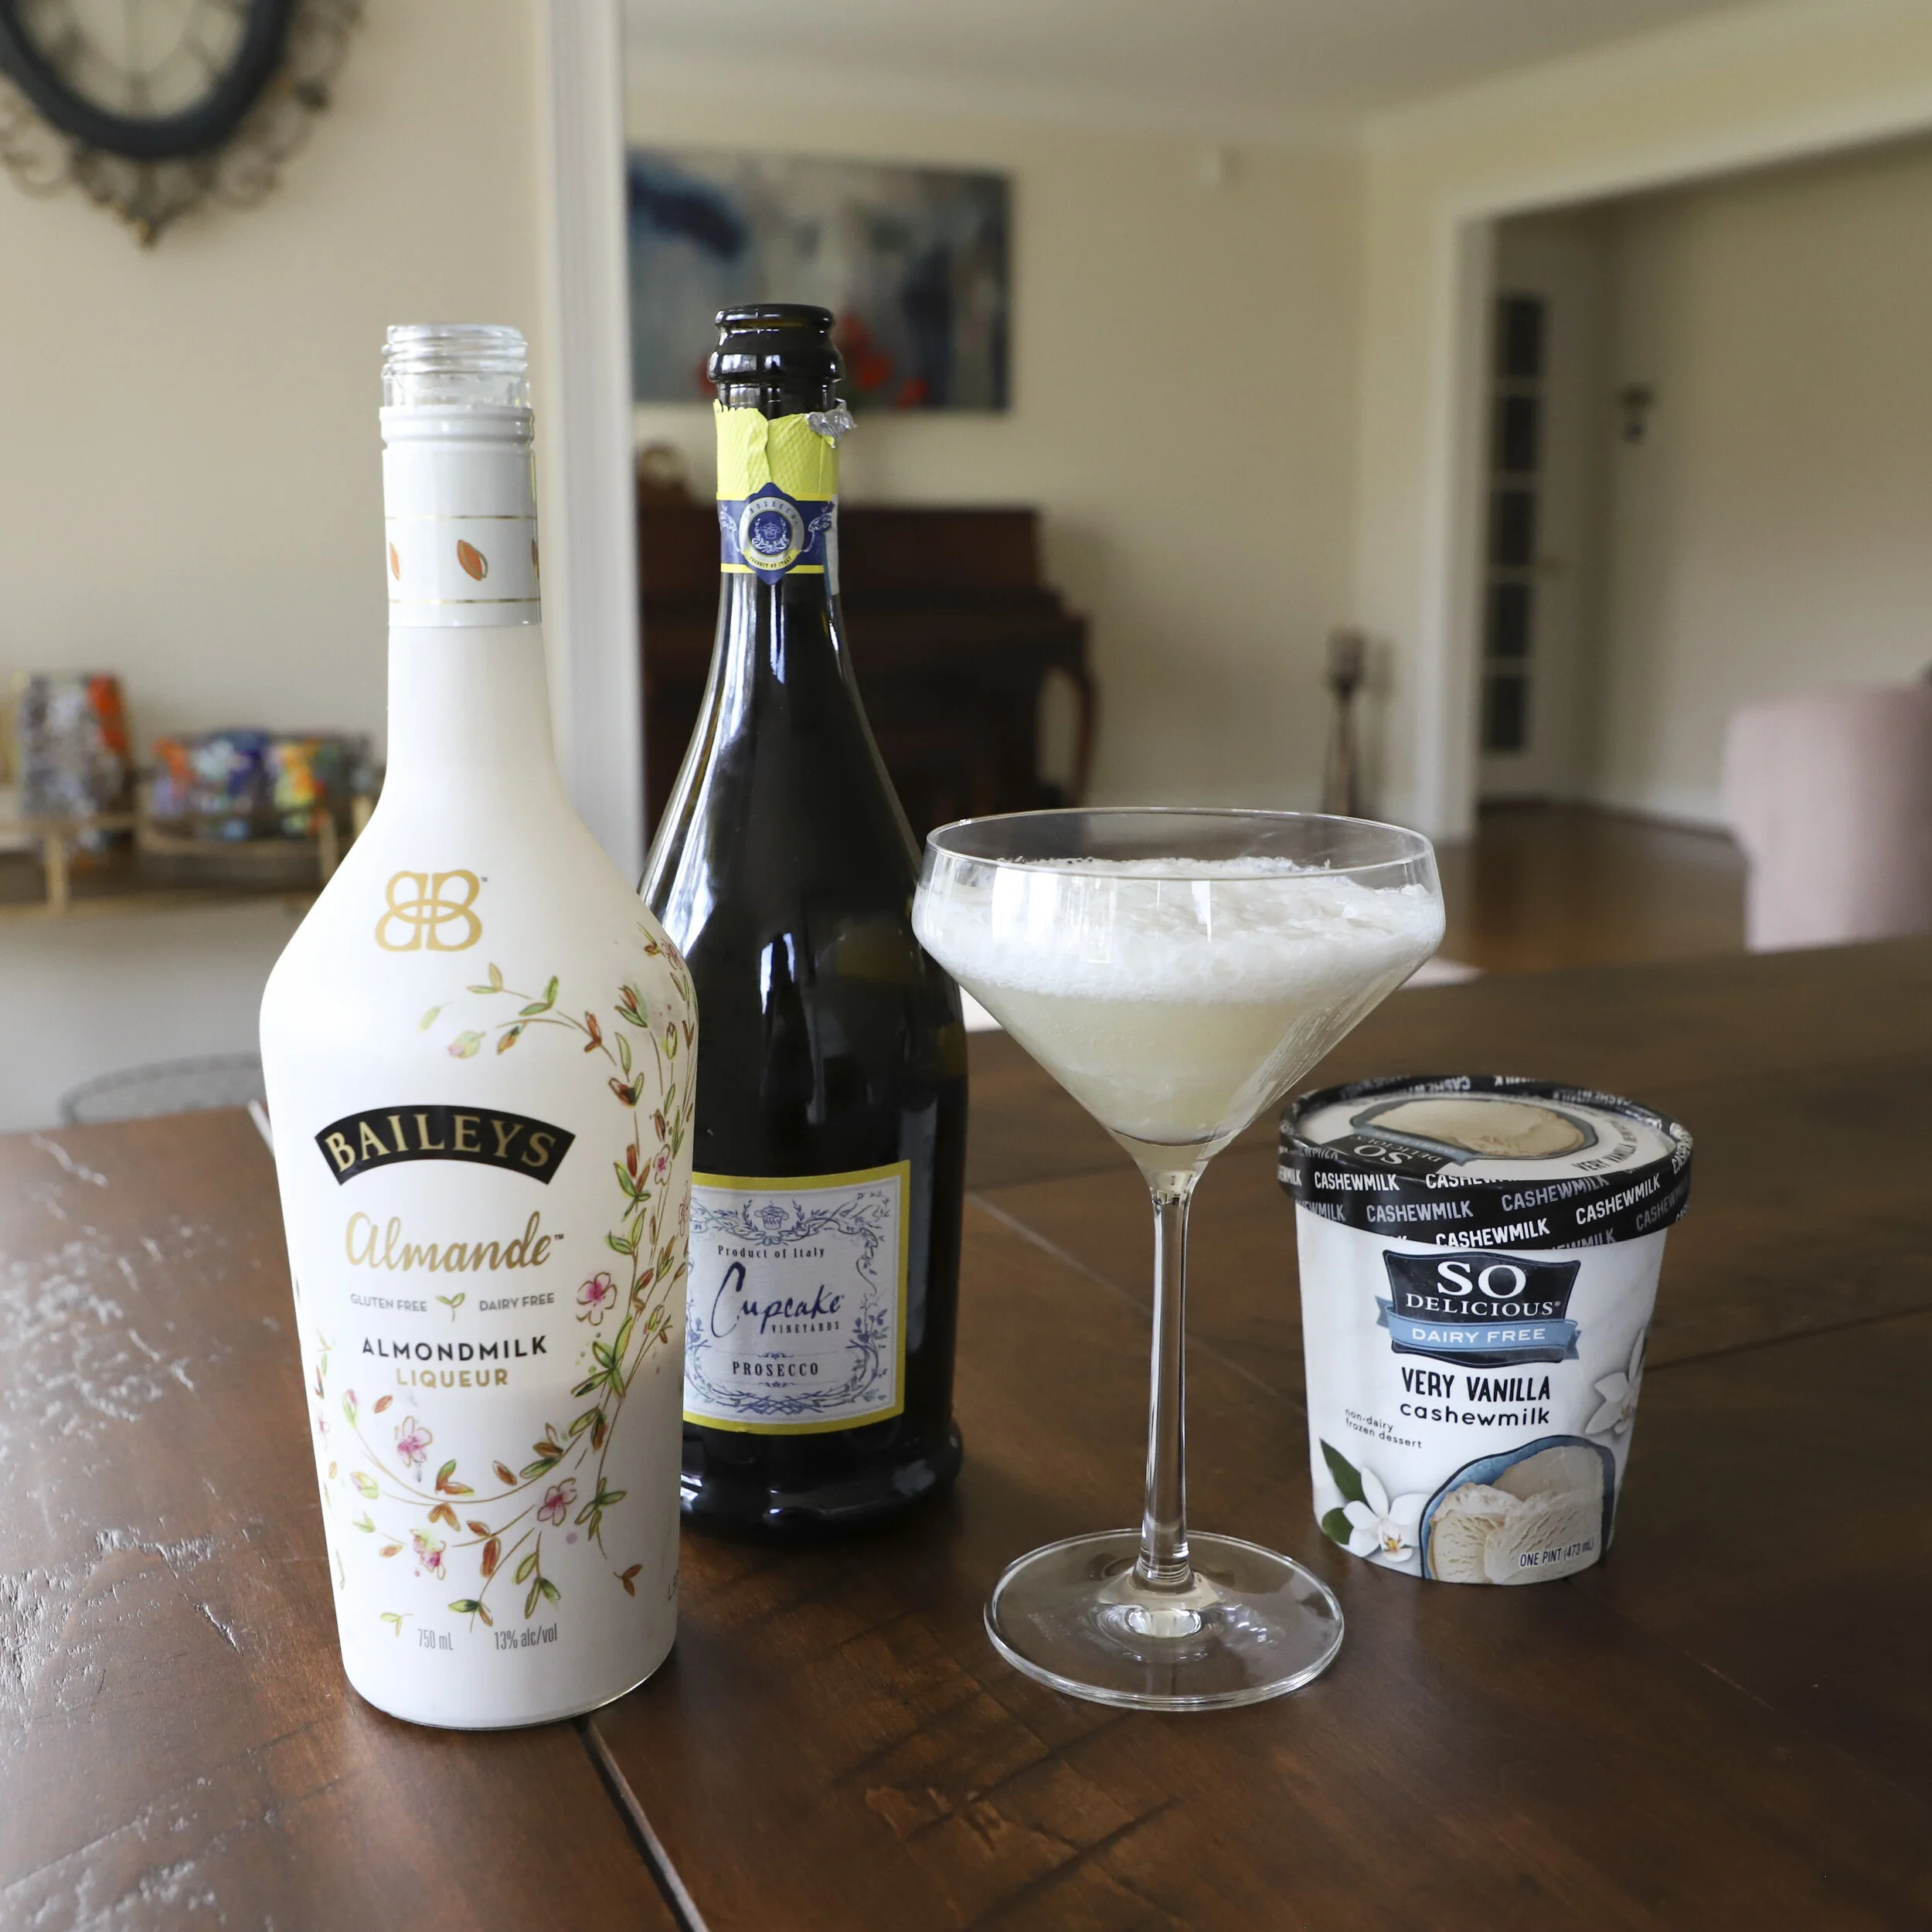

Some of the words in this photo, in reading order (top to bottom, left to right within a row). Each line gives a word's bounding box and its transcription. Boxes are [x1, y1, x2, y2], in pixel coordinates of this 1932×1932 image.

[325, 1113, 557, 1173] BAILEYS
[1314, 1172, 1400, 1191] CASHEWMILK
[1502, 1175, 1610, 1212] CASHEWMILK
[1576, 1173, 1661, 1225] CASHEWMILK
[1366, 1200, 1474, 1223] CASHEWMILK
[1435, 1218, 1550, 1249] CASHEWMILK
[718, 1245, 768, 1258] Product
[774, 1245, 787, 1258] of
[794, 1247, 825, 1258] Italy
[1437, 1260, 1526, 1299] SO
[350, 1293, 394, 1310] GLUTEN
[396, 1299, 427, 1312] FREE
[479, 1296, 520, 1311] DAIRY
[522, 1293, 555, 1307] FREE
[711, 1261, 841, 1338] Cupcake
[1406, 1293, 1553, 1316] DELICIOUS
[771, 1321, 839, 1334] VINEYARDS
[1412, 1327, 1479, 1344] DAIRY
[1487, 1327, 1546, 1343] FREE
[362, 1335, 547, 1361] ALMONDMILK
[396, 1368, 508, 1389] LIQUEUR
[733, 1361, 818, 1378] PROSECCO
[1401, 1367, 1454, 1398] VERY
[1467, 1376, 1550, 1403] VANILLA
[1345, 1408, 1394, 1433] non-dairy
[1400, 1403, 1549, 1427] cashewmilk
[1345, 1420, 1376, 1439] frozen
[1379, 1430, 1422, 1449] dessert
[1520, 1553, 1539, 1567] ONE
[1542, 1548, 1562, 1563] PINT
[1563, 1543, 1581, 1560] (473
[417, 1628, 436, 1649] 750
[494, 1631, 519, 1651] 13%
[520, 1623, 557, 1648] alc/vol
